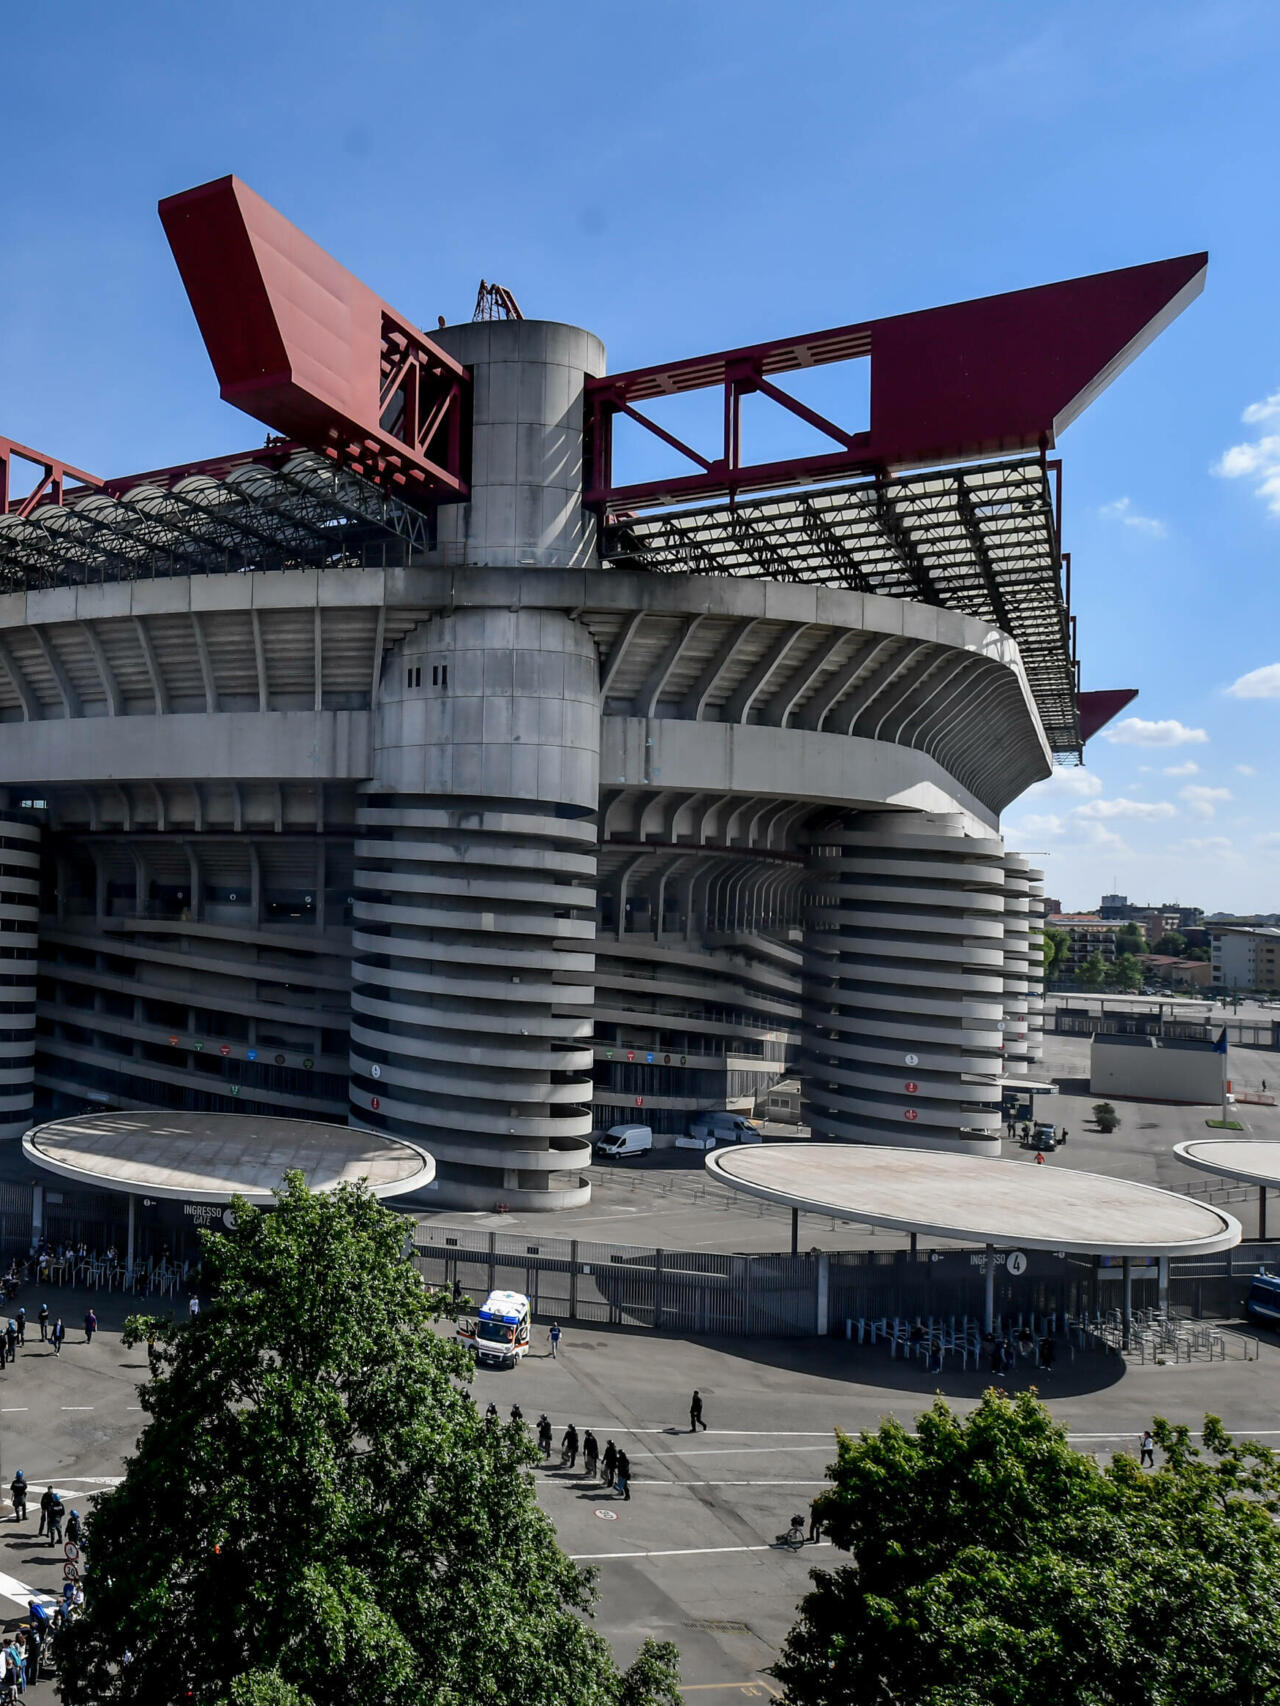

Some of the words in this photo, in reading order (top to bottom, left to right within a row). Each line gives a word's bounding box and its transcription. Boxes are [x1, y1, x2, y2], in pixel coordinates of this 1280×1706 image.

[183, 1204, 222, 1218] INGRESSO
[193, 1215, 211, 1226] GATE
[66, 1566, 76, 1577] 30
